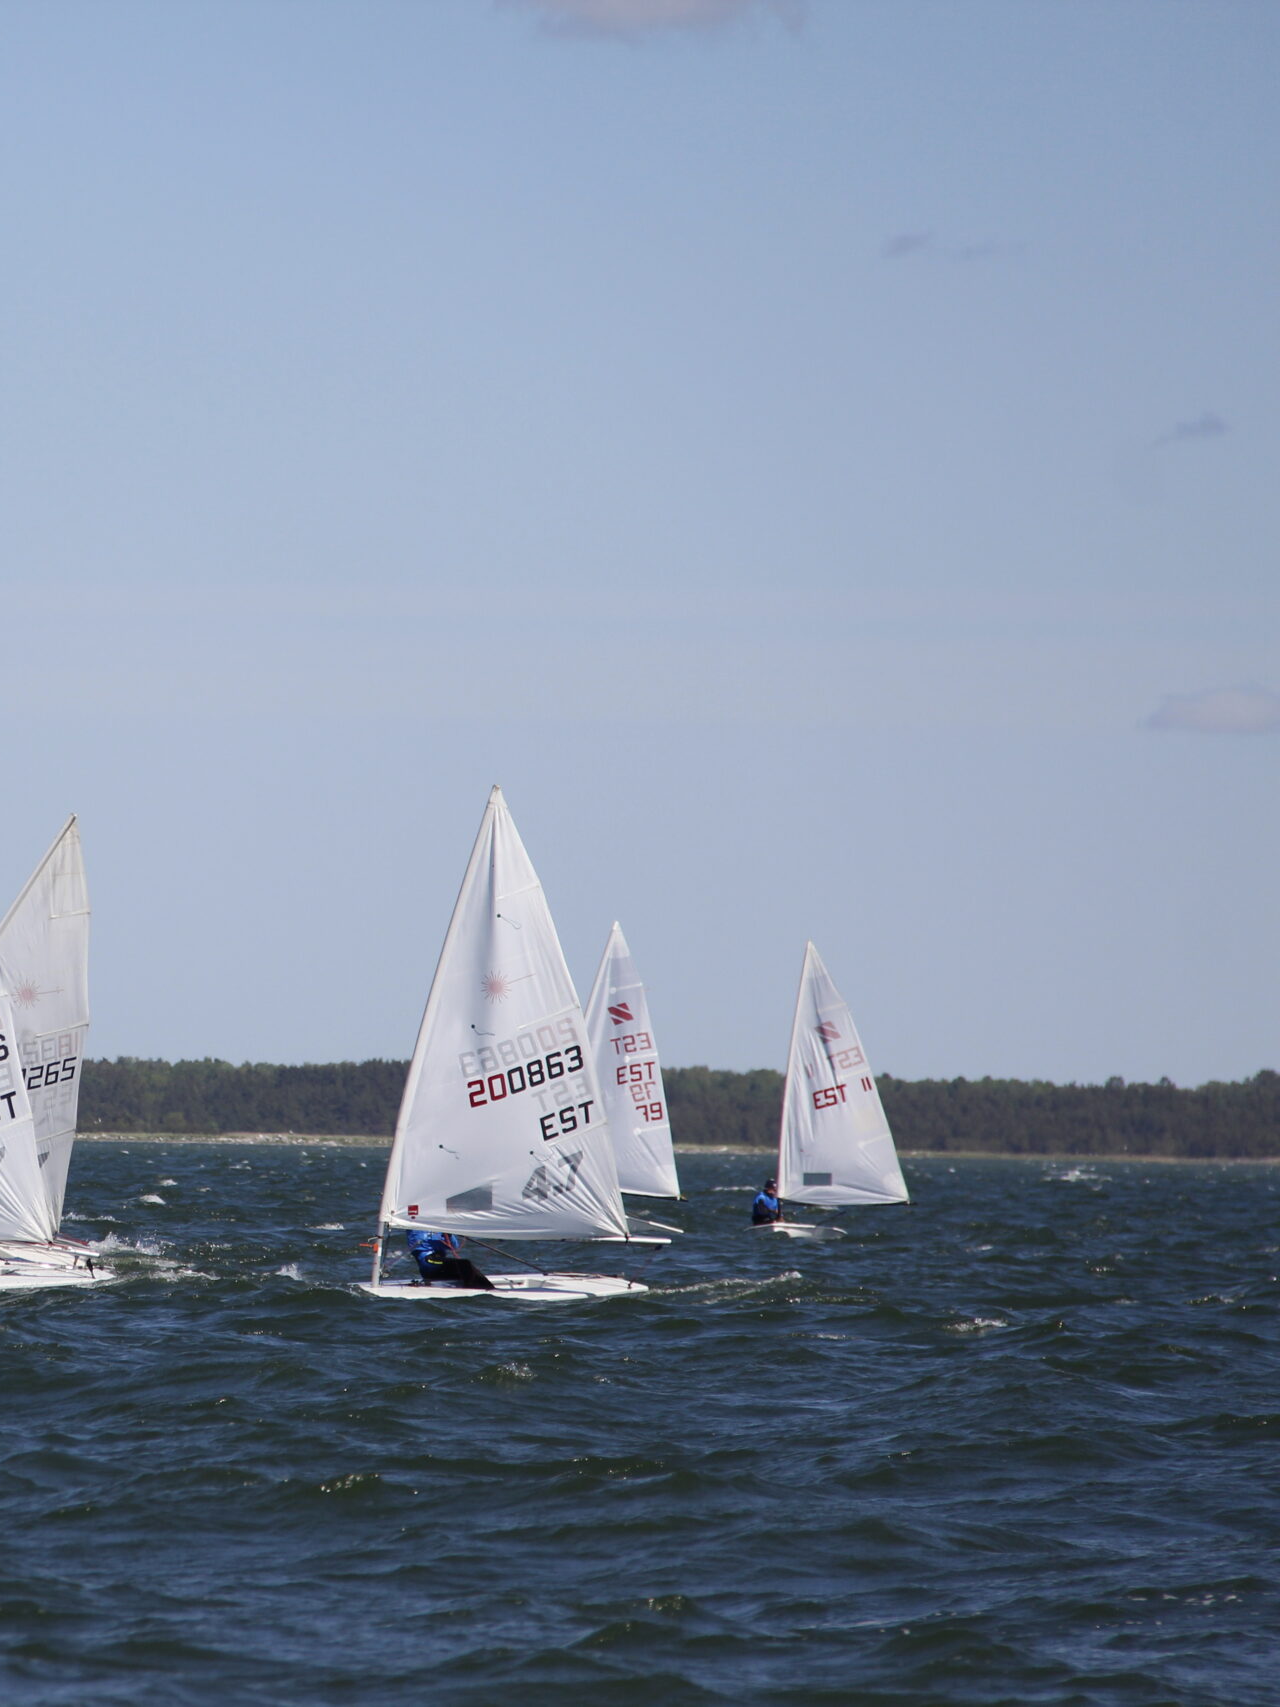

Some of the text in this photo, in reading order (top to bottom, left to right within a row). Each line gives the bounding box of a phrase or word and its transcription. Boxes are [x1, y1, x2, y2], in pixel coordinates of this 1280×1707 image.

[22, 1057, 77, 1090] 265
[467, 1045, 583, 1108] 200863
[616, 1062, 655, 1085] EST
[813, 1076, 872, 1109] EST 11
[539, 1100, 594, 1141] EST
[636, 1102, 663, 1122] 79
